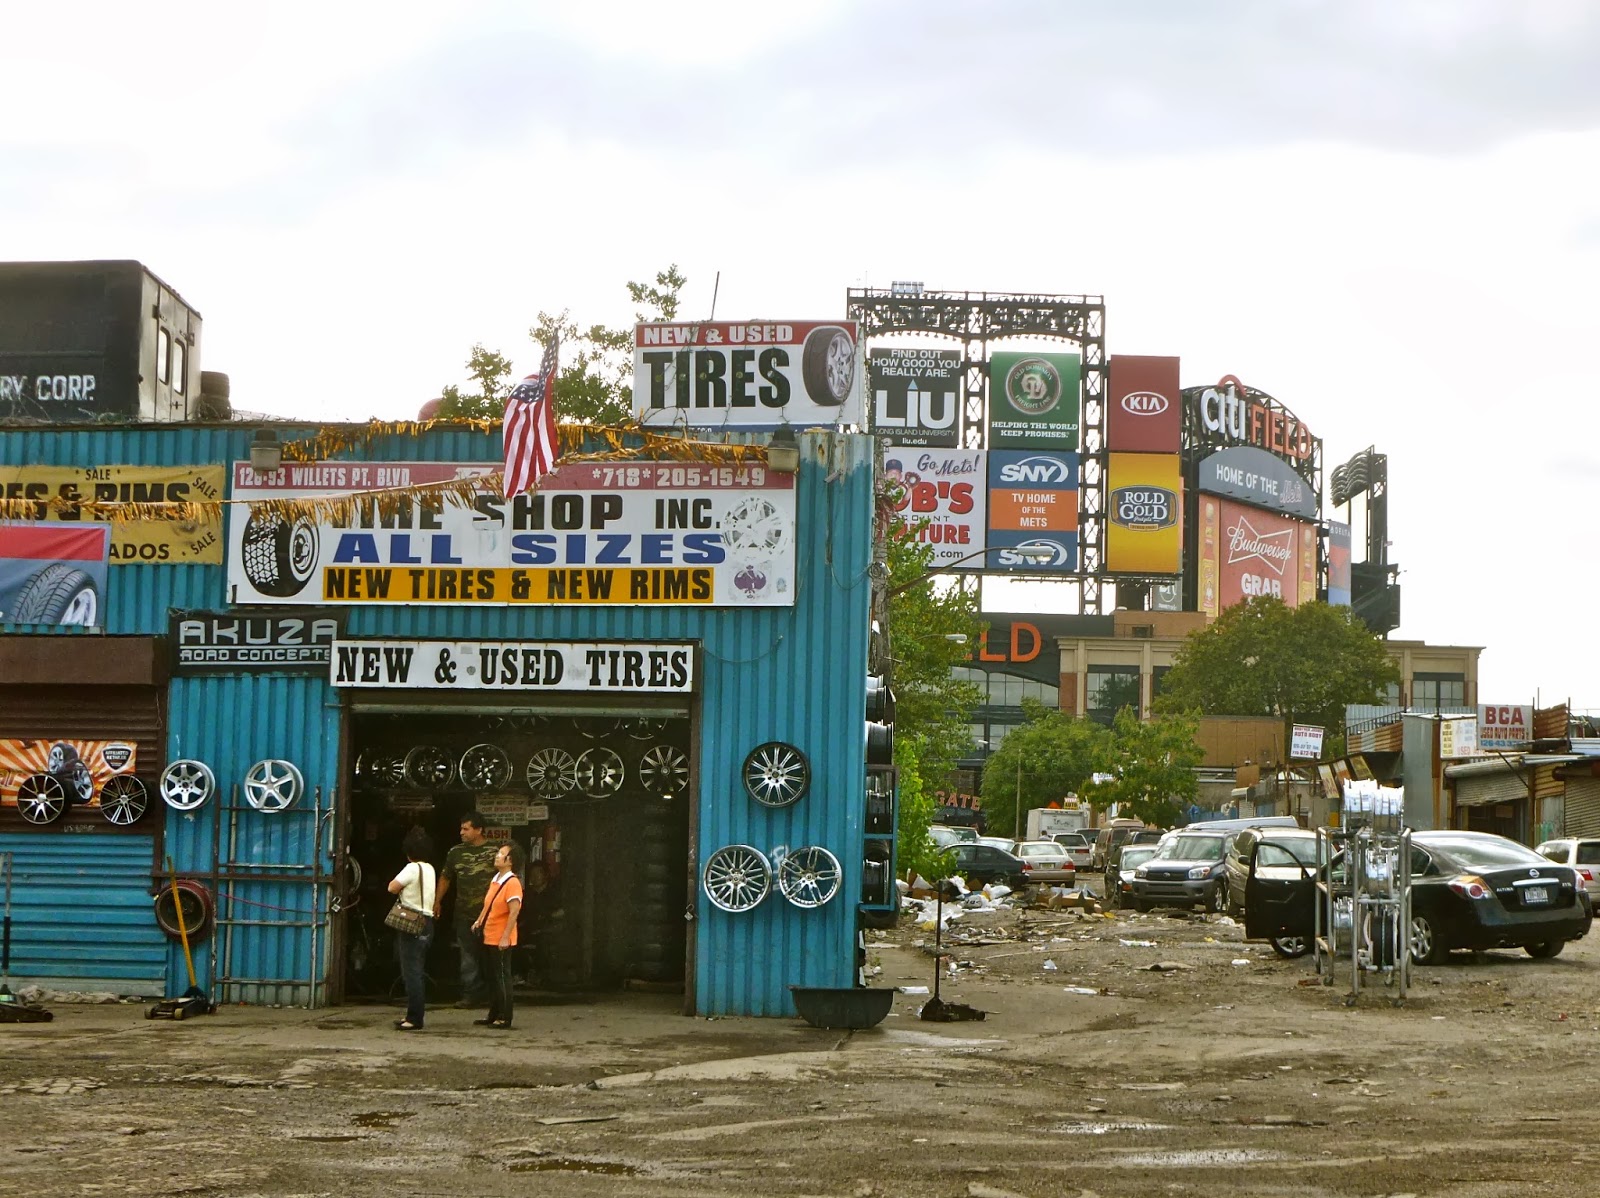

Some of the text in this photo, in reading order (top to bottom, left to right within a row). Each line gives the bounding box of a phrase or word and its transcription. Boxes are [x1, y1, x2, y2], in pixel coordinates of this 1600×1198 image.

[643, 325, 793, 345] NEW & USED
[872, 358, 961, 369] HOW GOOD YOU
[891, 349, 942, 359] FIND OUT
[643, 348, 791, 409] TIRES
[882, 367, 951, 378] REALLY ARE.
[36, 374, 96, 401] CORP.
[1129, 397, 1161, 410] KIA
[919, 429, 955, 437] UNIVERSITY
[991, 421, 1029, 429] HELPING
[1250, 403, 1312, 460] FIELD
[902, 437, 927, 445] liu.edu
[917, 453, 980, 476] Go Mets!
[1000, 464, 1058, 483] SNY
[85, 469, 111, 481] SALE
[291, 467, 346, 486] WILLETS
[352, 468, 371, 487] PT.
[377, 468, 413, 487] BLVD.
[656, 467, 765, 487] 205-1549
[1216, 464, 1244, 486] HOME
[1246, 473, 1258, 489] OF
[1260, 477, 1278, 496] THE
[191, 476, 218, 500] SALE
[1123, 491, 1165, 505] ROLD
[94, 483, 190, 522] RIMS
[1012, 493, 1056, 504] TV HOME
[655, 498, 721, 530] INC.
[1022, 506, 1031, 514] OF
[1119, 504, 1168, 519] GOLD
[1020, 516, 1048, 527] METS
[190, 531, 217, 556] SALE
[333, 533, 726, 564] ALL SIZES
[1227, 526, 1292, 560] Budweiser
[326, 569, 711, 600] NEW TIRES & NEW RIMS
[1241, 573, 1282, 600] GRAB
[179, 619, 338, 646] AKUZA
[237, 648, 331, 662] CONCEPTS
[336, 647, 688, 688] NEW & USED TIRES
[1485, 706, 1524, 725] BCA
[935, 790, 981, 811] GATE
